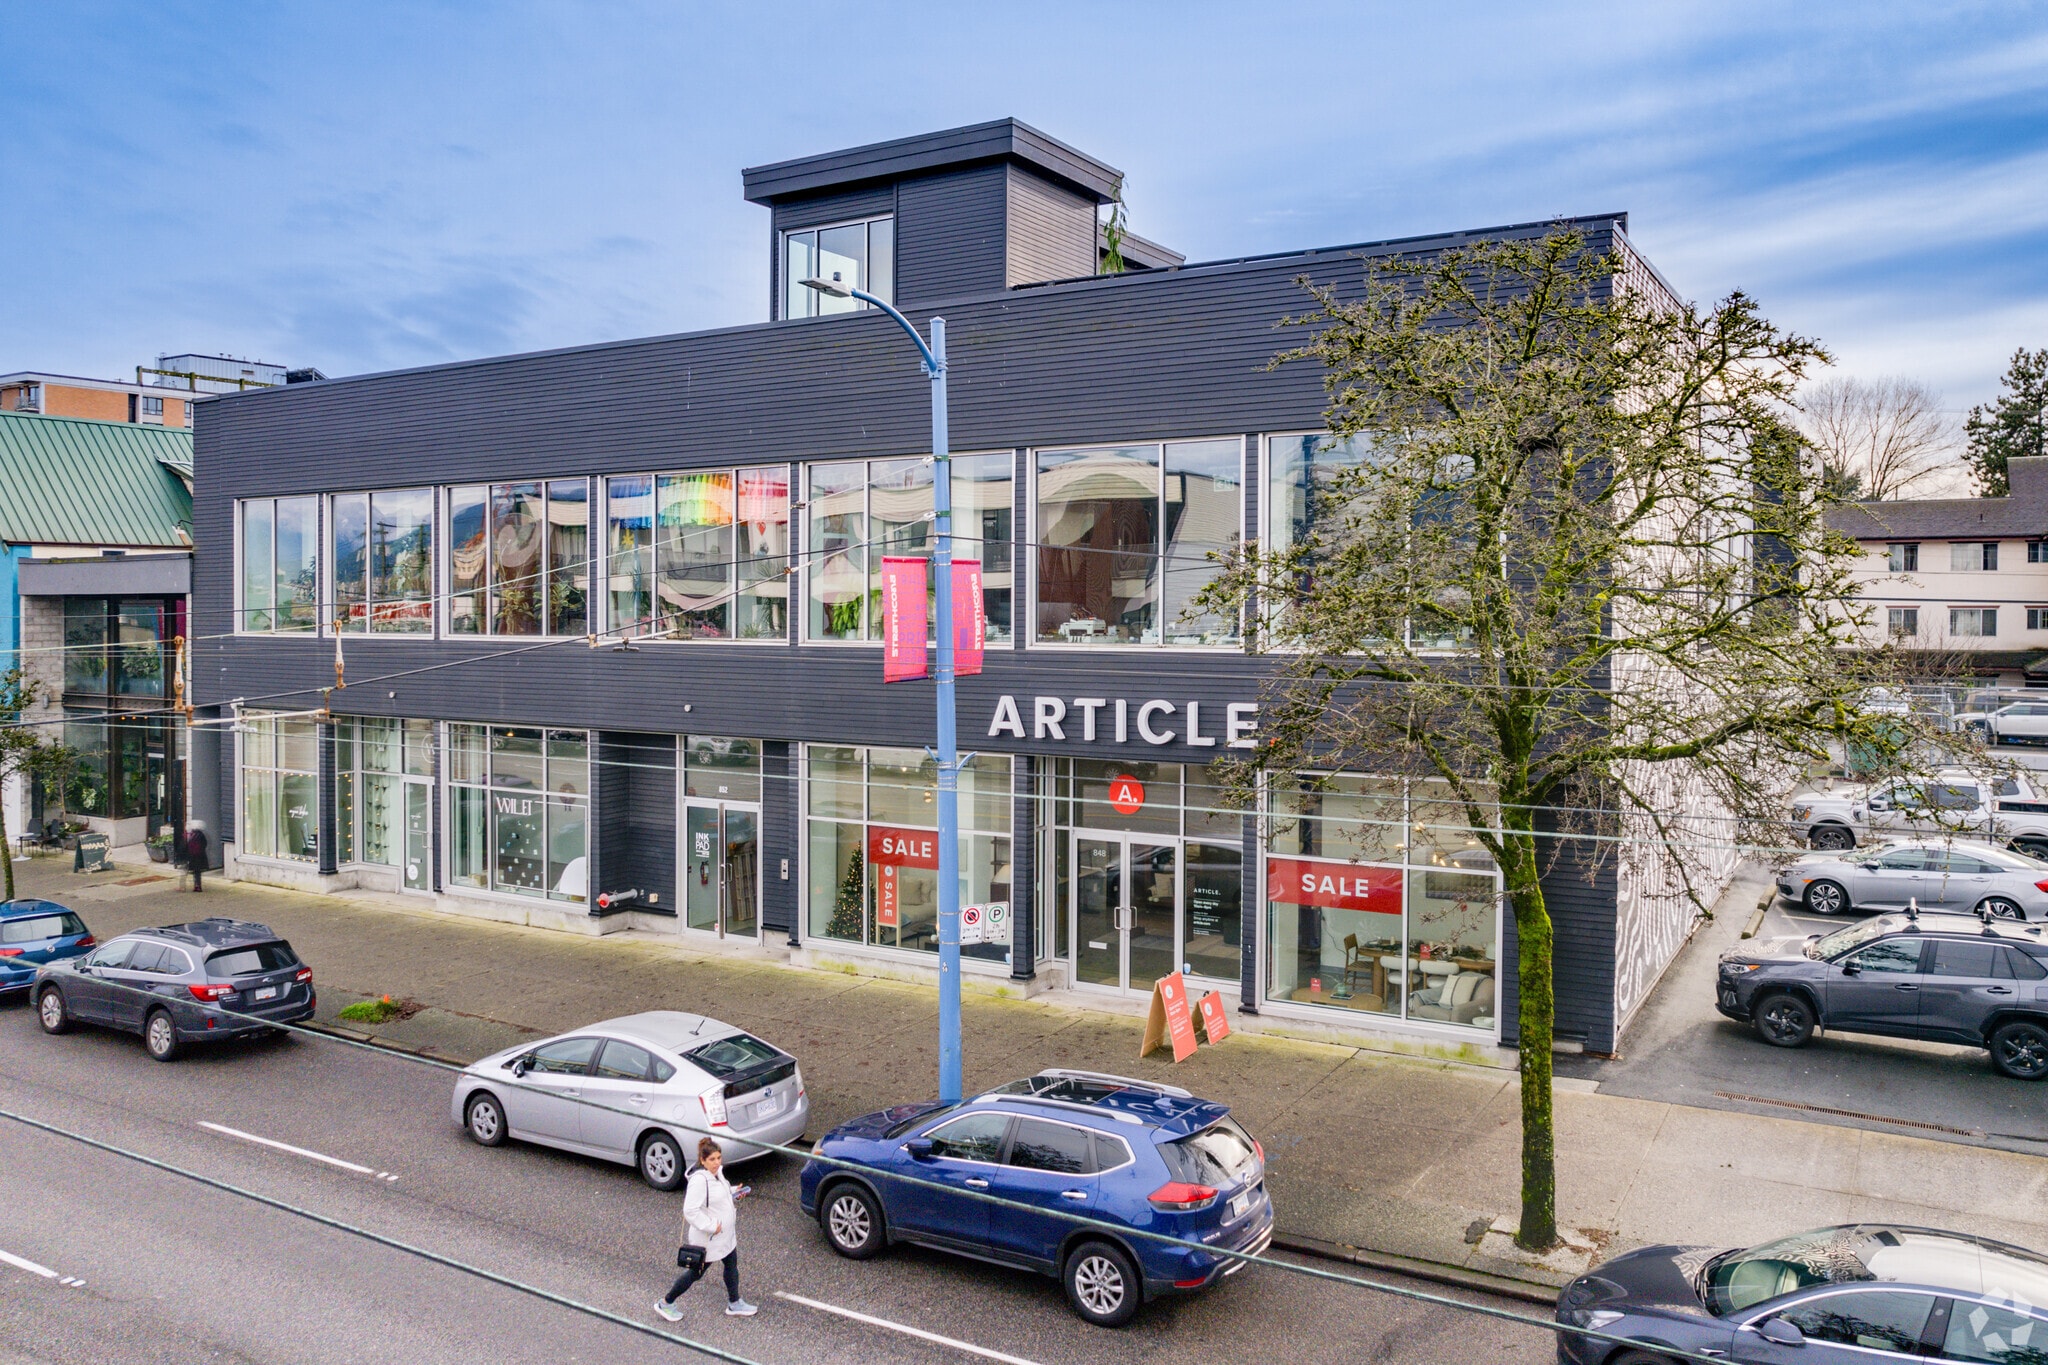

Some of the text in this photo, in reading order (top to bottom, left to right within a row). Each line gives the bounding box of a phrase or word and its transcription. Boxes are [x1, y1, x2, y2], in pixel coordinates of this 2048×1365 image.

[988, 695, 1259, 748] ARTICLE
[695, 832, 710, 841] INK
[695, 840, 710, 851] PAD
[882, 837, 932, 859] SALE
[1092, 848, 1107, 857] 848
[1301, 873, 1369, 898] SALE
[884, 881, 893, 917] SALE
